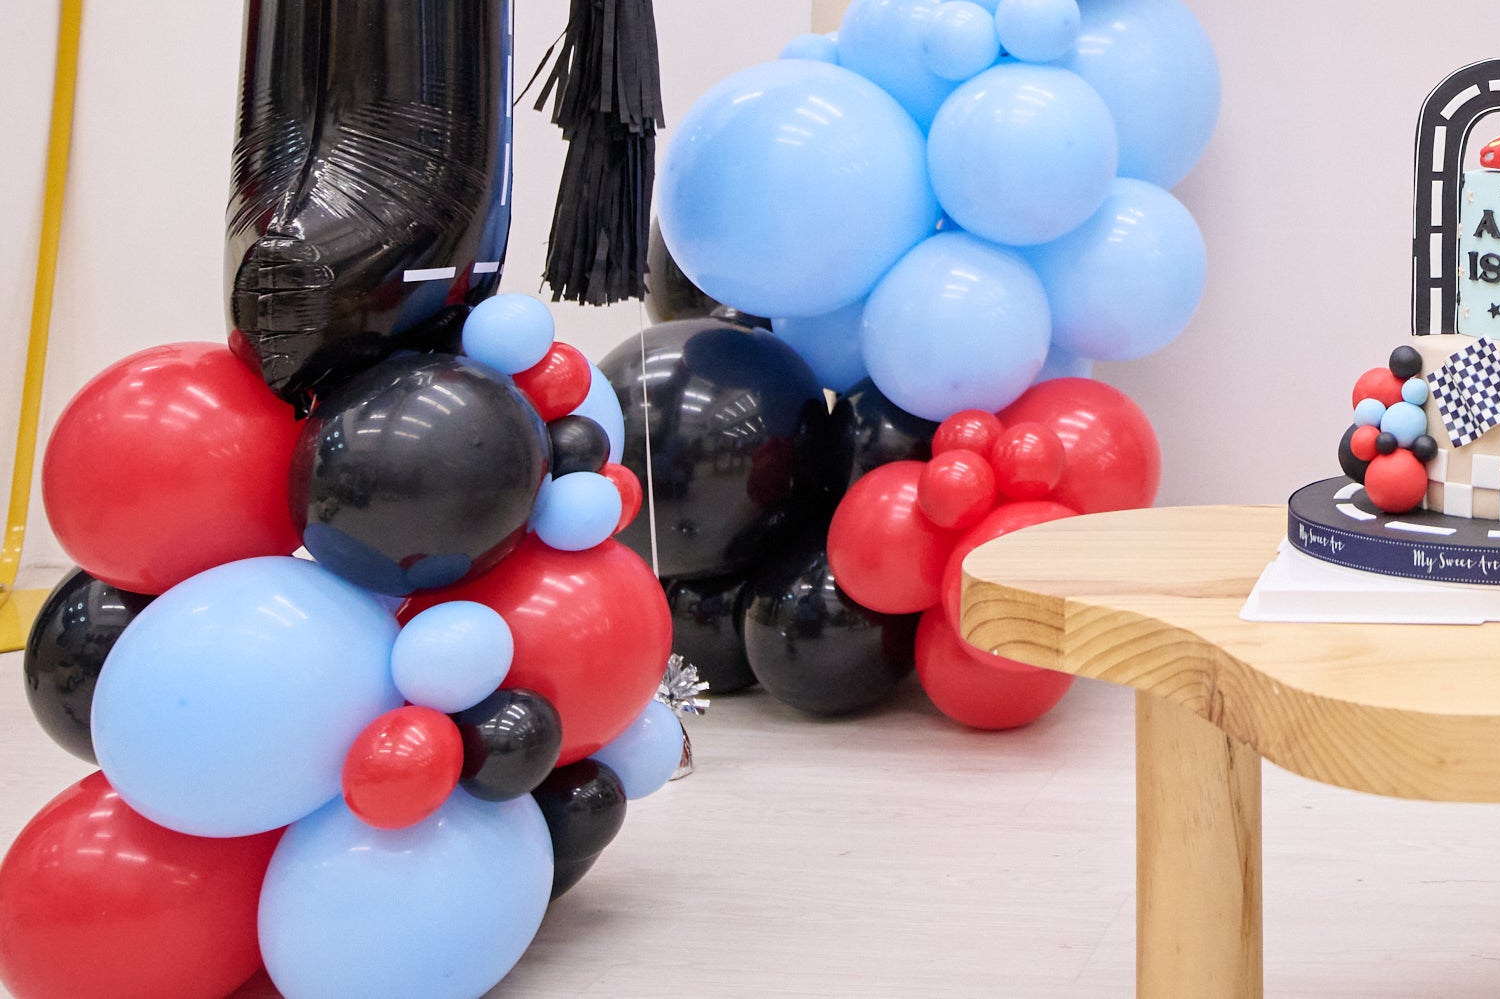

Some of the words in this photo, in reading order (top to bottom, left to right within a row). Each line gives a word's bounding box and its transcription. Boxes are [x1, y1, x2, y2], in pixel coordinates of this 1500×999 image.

[1299, 522, 1310, 547] My
[1309, 529, 1329, 547] Sweet
[1329, 534, 1346, 554] Art
[1412, 549, 1437, 574] My
[1438, 552, 1478, 570] Sweet
